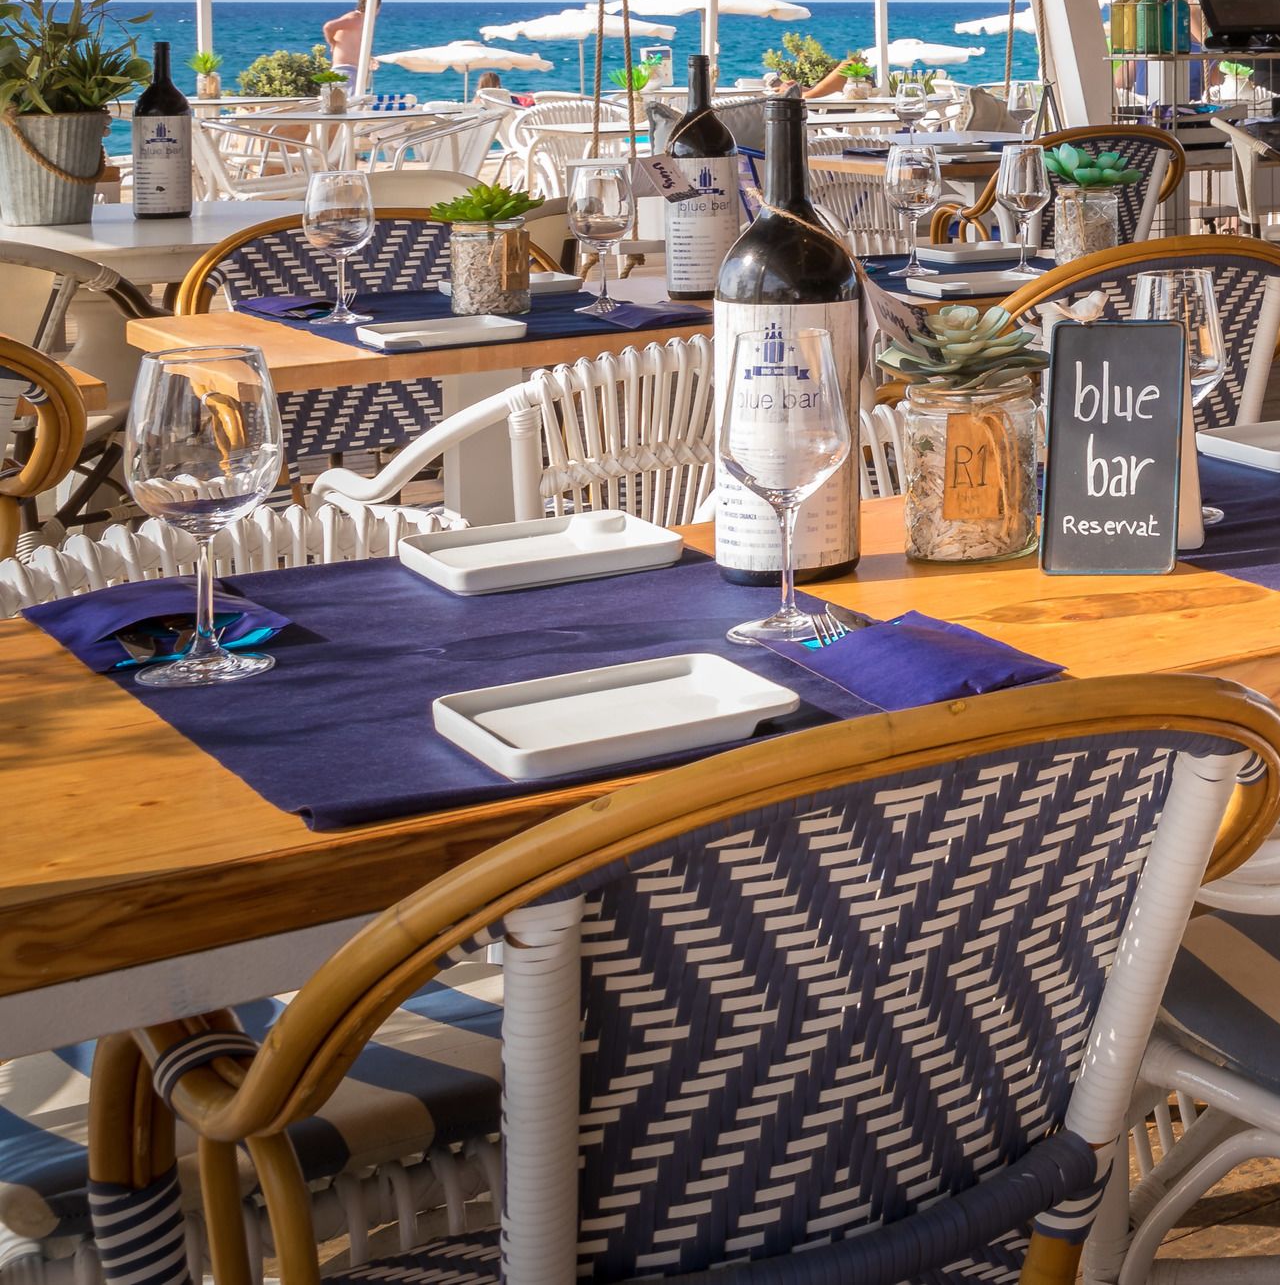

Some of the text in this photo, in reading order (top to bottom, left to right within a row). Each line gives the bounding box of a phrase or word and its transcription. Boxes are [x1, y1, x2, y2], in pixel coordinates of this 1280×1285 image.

[680, 199, 731, 212] blue bar
[782, 388, 820, 410] bar
[1074, 360, 1160, 424] blue
[952, 444, 990, 489] R1
[1086, 433, 1155, 498] bar
[1063, 515, 1160, 537] Reservat
